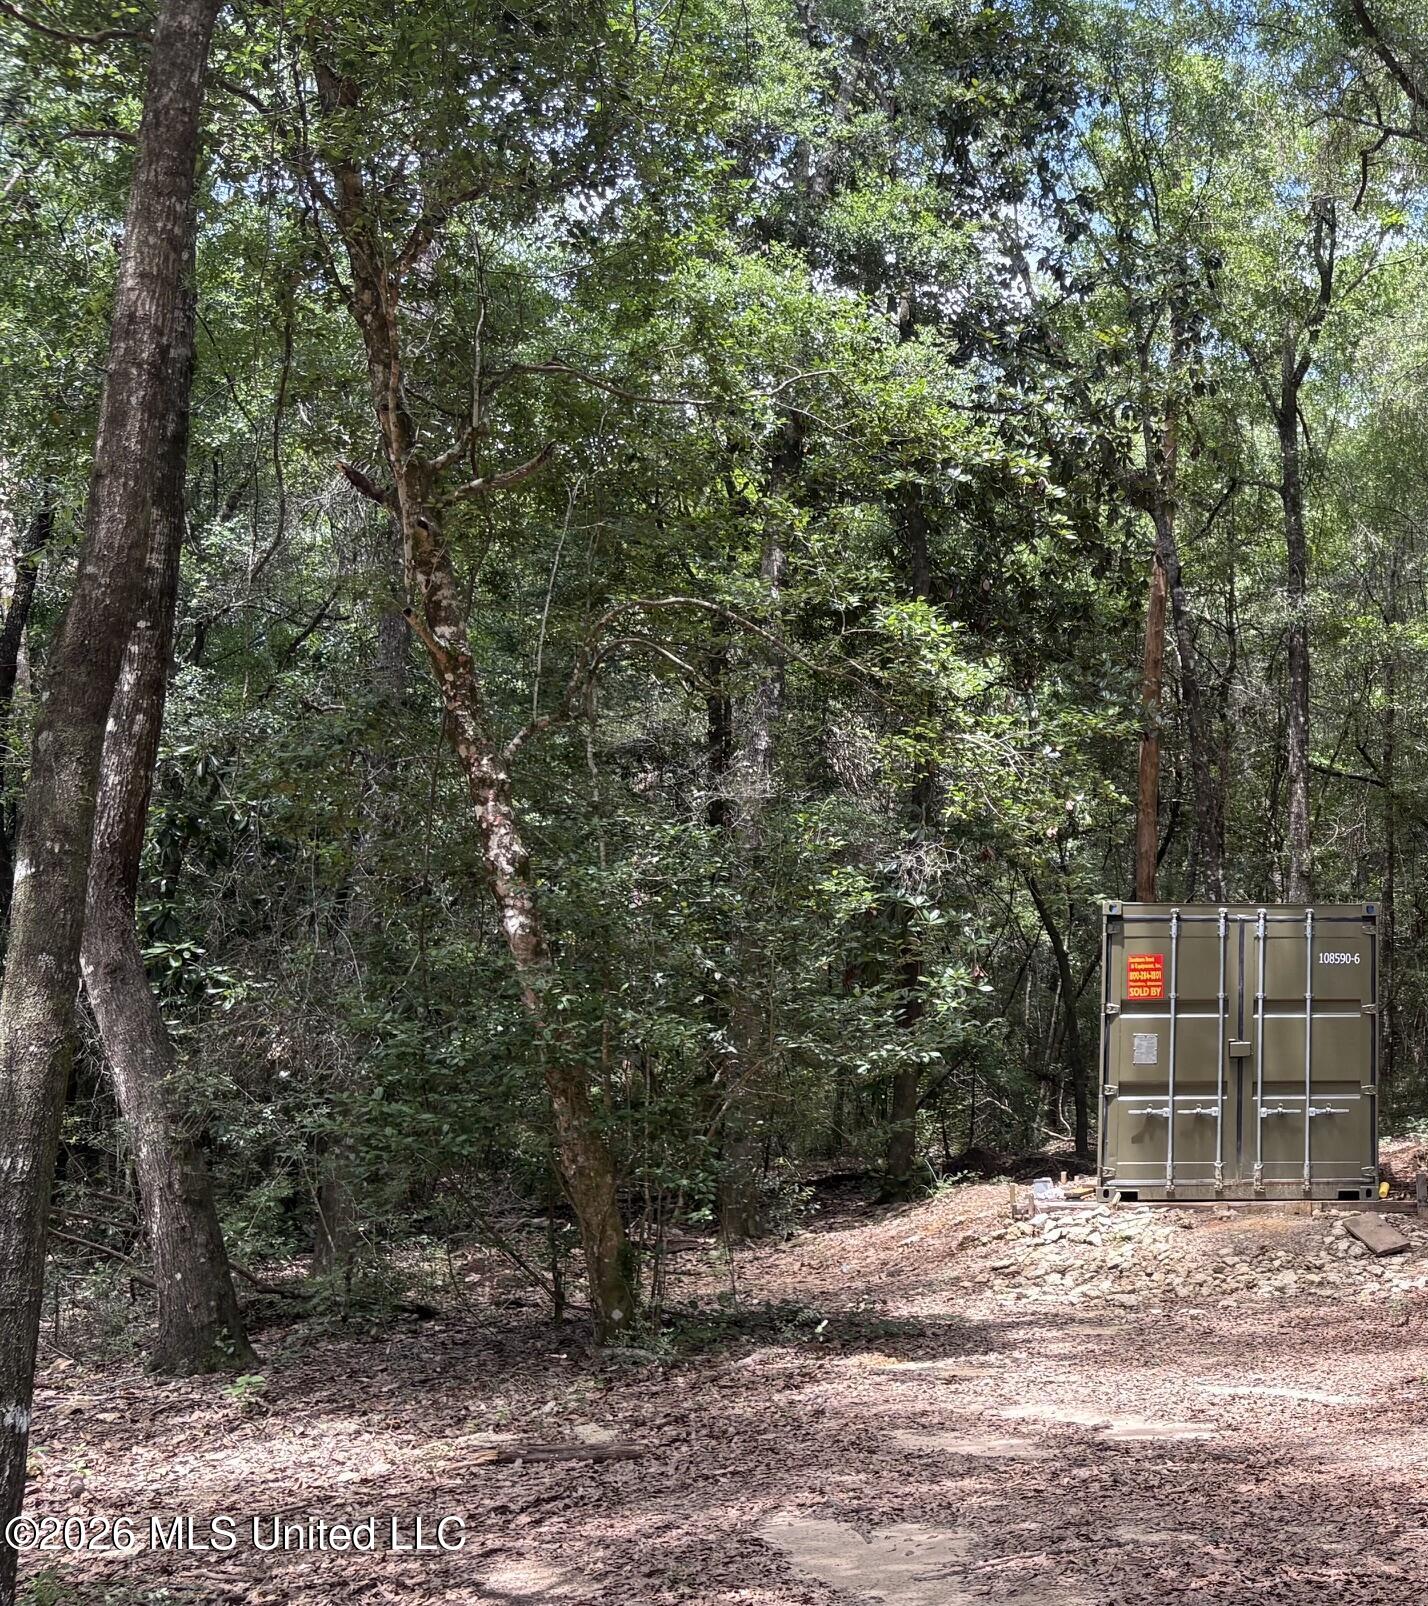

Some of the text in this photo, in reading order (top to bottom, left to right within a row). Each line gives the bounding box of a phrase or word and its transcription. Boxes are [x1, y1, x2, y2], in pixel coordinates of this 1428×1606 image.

[1318, 952, 1361, 965] 108590-6
[1129, 986, 1162, 996] SOLD BY
